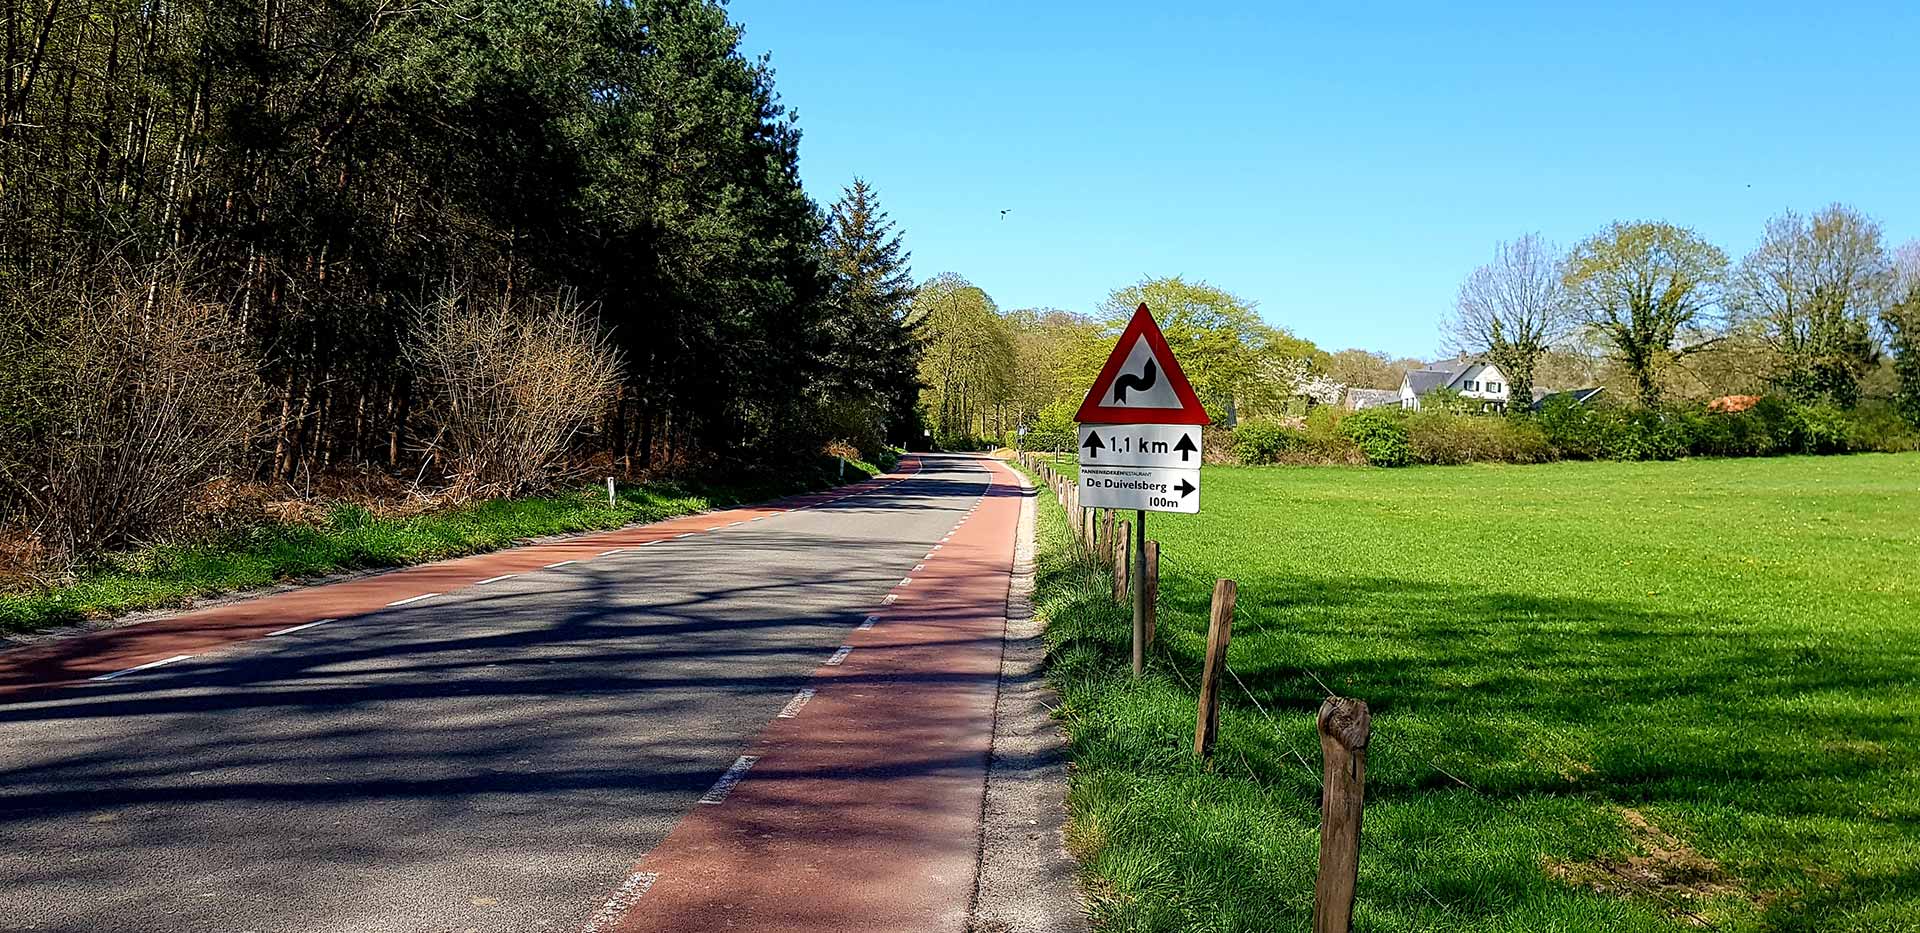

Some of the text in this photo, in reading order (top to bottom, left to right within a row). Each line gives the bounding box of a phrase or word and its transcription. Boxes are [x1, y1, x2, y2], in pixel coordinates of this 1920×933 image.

[1139, 437, 1168, 454] km
[1086, 478, 1167, 493] De Duivelsberg
[1149, 497, 1179, 508] 100m
